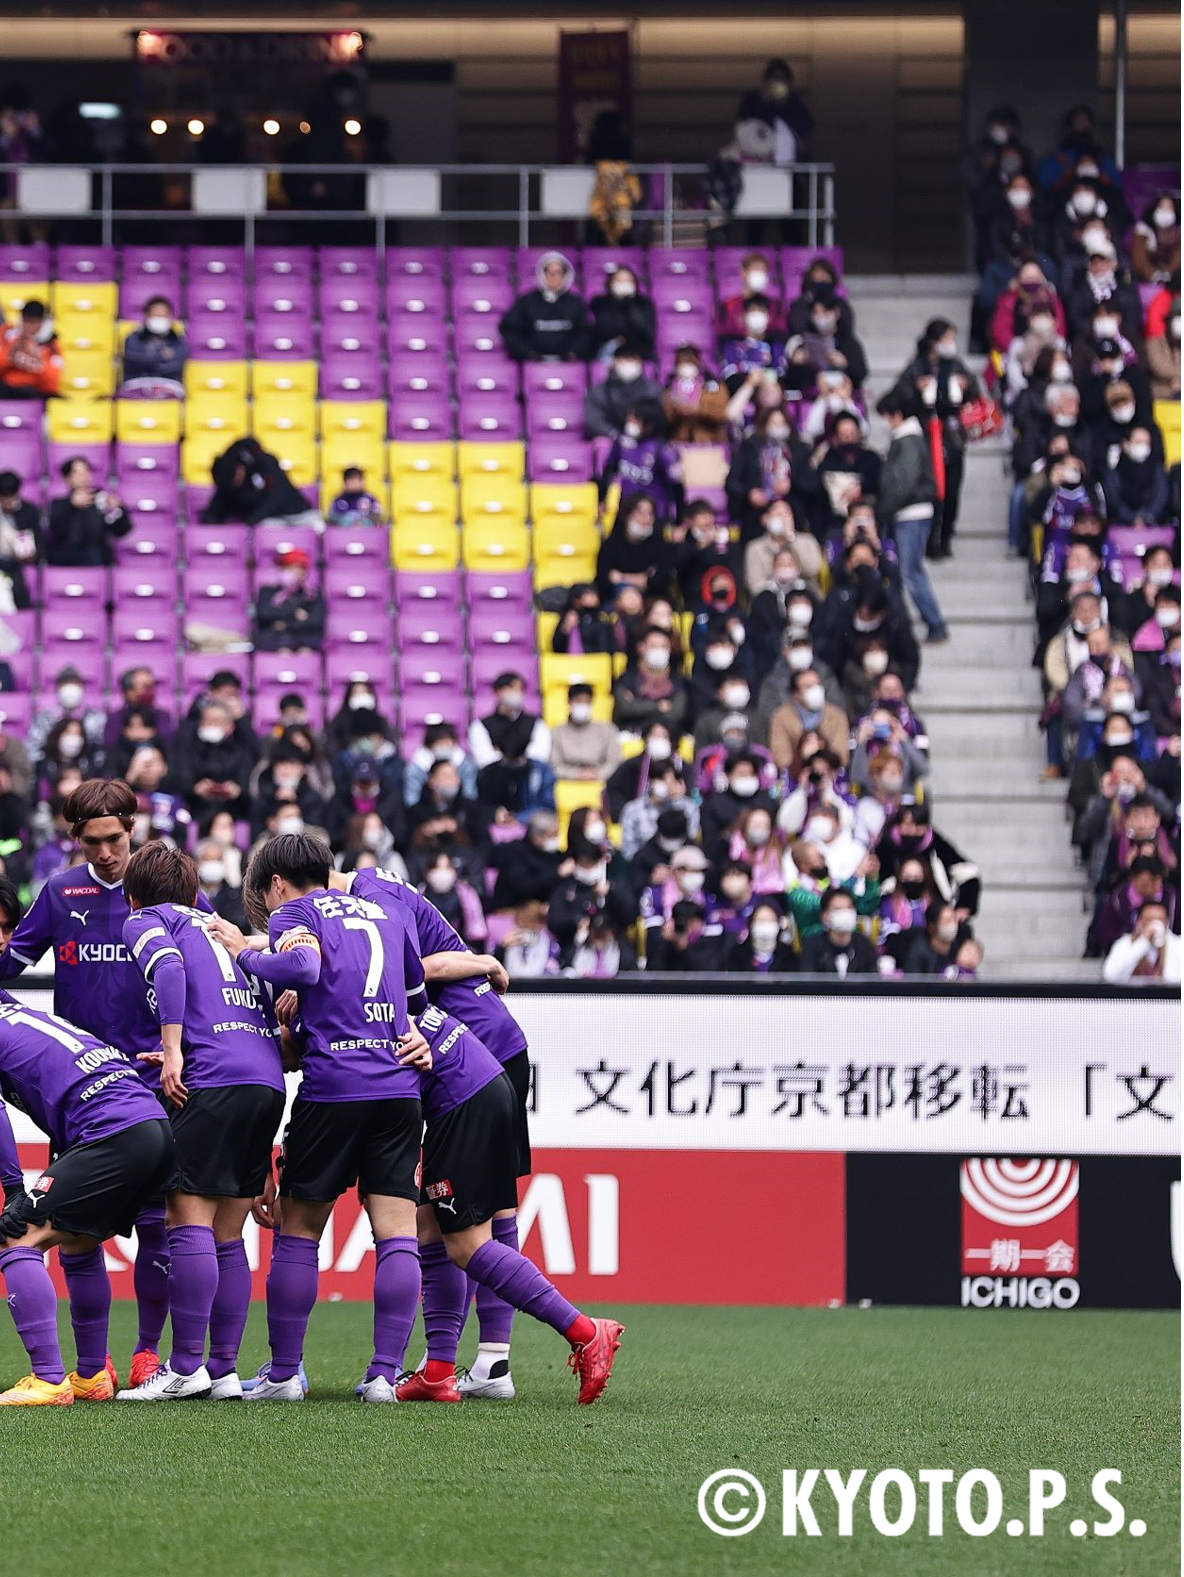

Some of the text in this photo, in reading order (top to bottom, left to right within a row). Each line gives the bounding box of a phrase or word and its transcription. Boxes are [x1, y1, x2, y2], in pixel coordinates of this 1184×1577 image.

[72, 887, 99, 895] WACOAL
[342, 917, 385, 997] 7
[212, 1021, 257, 1034] RESPECT
[330, 1038, 404, 1052] RESPECT YO
[964, 1238, 1076, 1273] 一期一会
[960, 1276, 1081, 1310] ICHIGO
